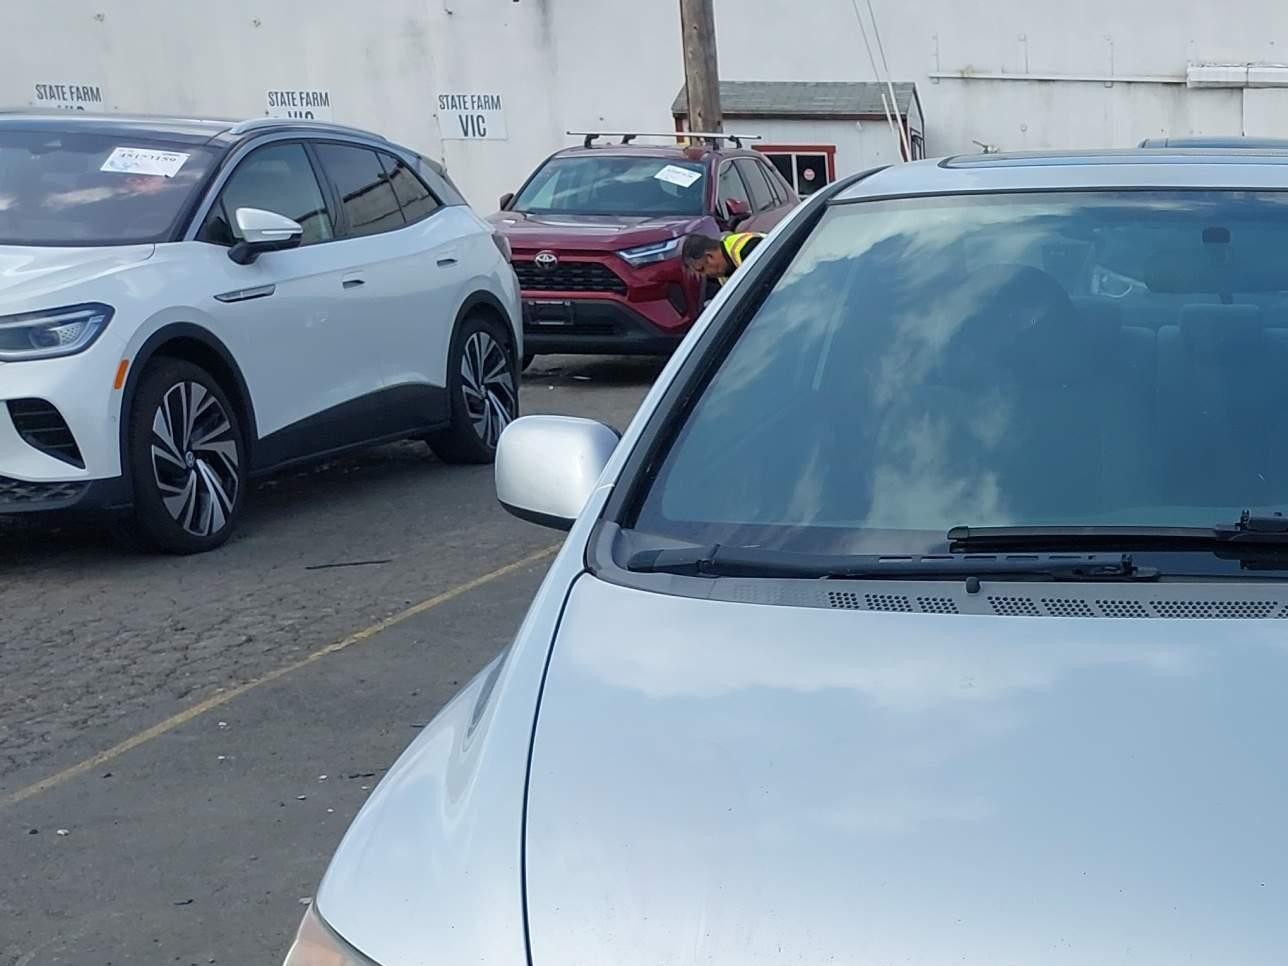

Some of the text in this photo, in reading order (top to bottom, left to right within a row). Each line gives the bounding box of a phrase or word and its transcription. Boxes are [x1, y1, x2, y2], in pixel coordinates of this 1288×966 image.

[35, 83, 102, 103] STATE FARM
[268, 91, 330, 107] STATE FARM
[438, 94, 502, 110] STATE FARM
[458, 114, 487, 137] VIC
